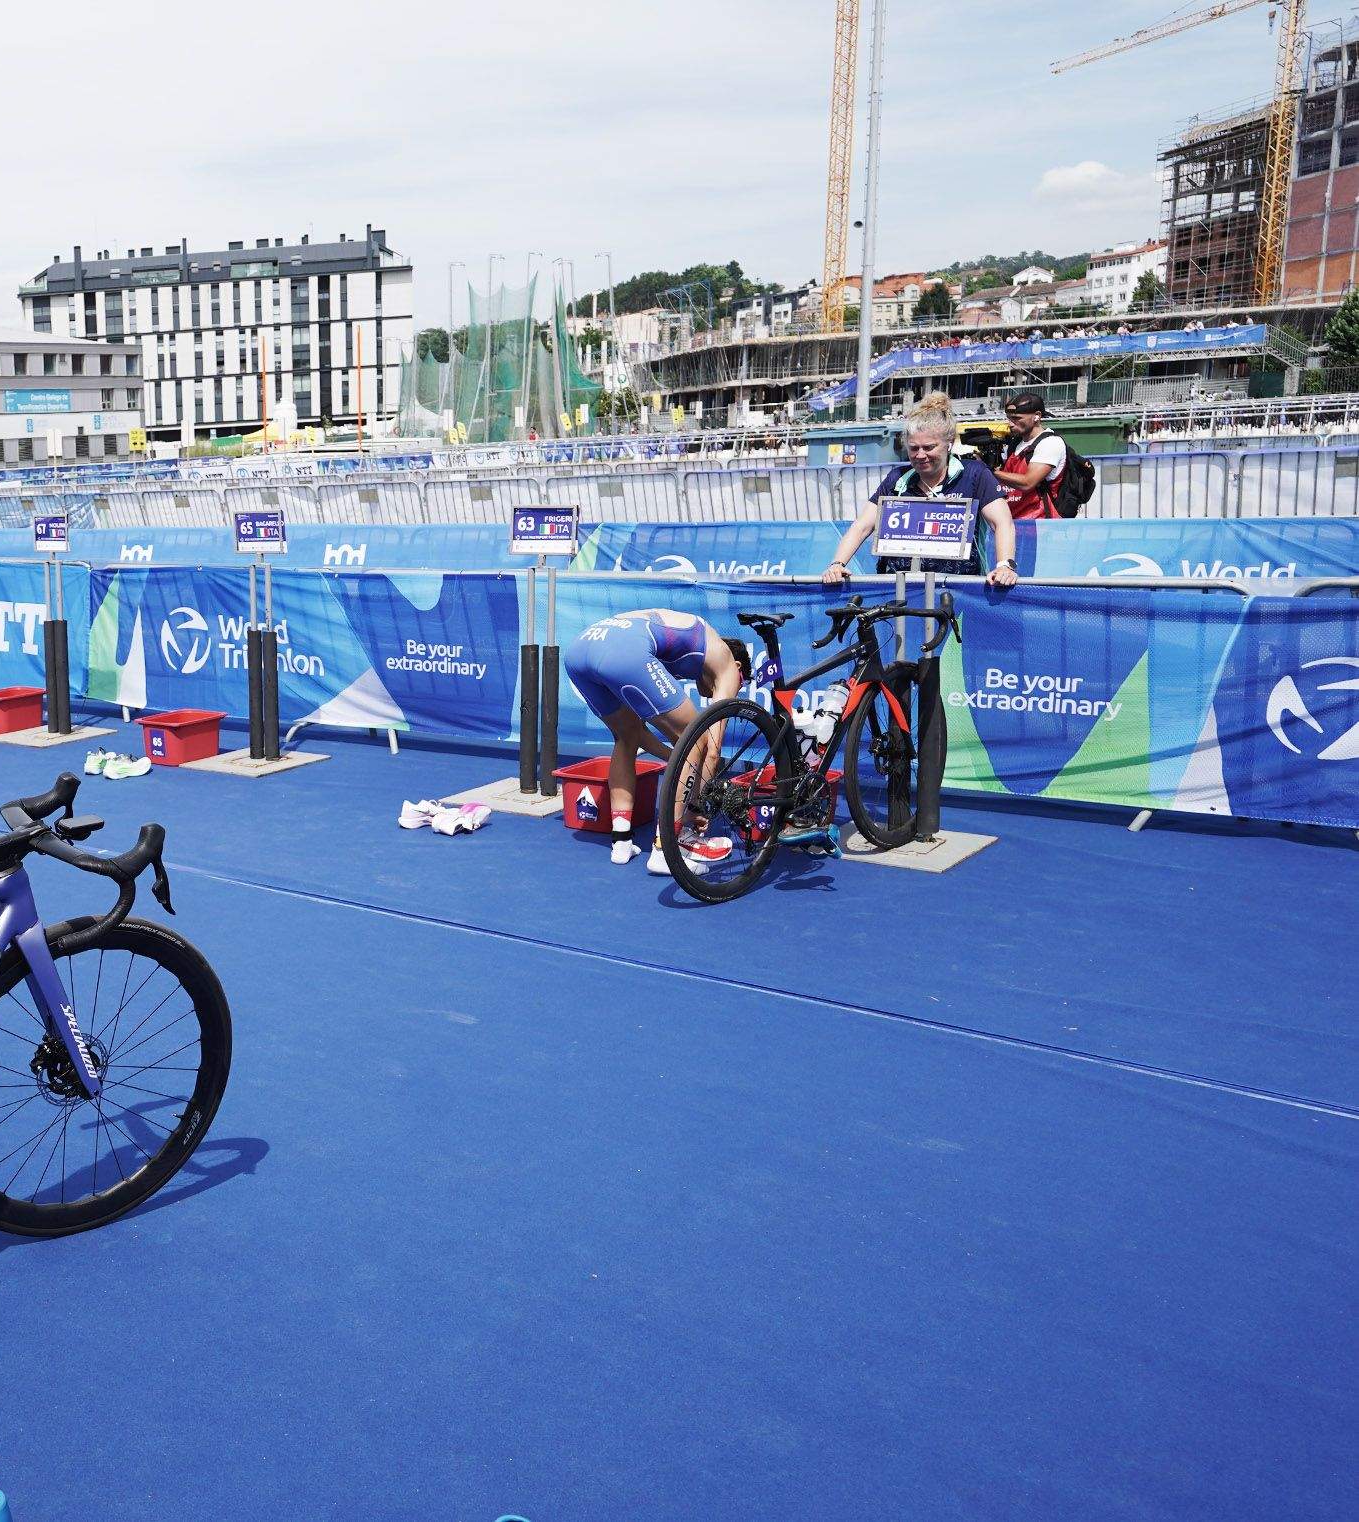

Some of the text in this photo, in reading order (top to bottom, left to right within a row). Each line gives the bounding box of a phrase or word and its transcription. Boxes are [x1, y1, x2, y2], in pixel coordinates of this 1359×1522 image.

[36, 523, 46, 535] 67
[240, 521, 253, 535] 65
[517, 516, 535, 531] 63
[555, 524, 569, 533] ITA
[888, 512, 910, 529] 61
[939, 523, 965, 534] FRA
[708, 560, 786, 575] World
[1182, 560, 1297, 579] World
[580, 627, 609, 641] FRA
[406, 640, 464, 660] Be your
[219, 642, 325, 677] Trihlon
[386, 657, 487, 680] extraordinary
[767, 663, 778, 676] 61
[655, 680, 669, 698] Crise
[657, 668, 677, 695] Clinique
[985, 668, 1084, 695] Be your
[947, 691, 1123, 722] extraordinary
[152, 737, 162, 747] 65
[682, 776, 695, 804] 61
[760, 805, 775, 816] 61
[60, 1003, 98, 1079] SPECIALIZED
